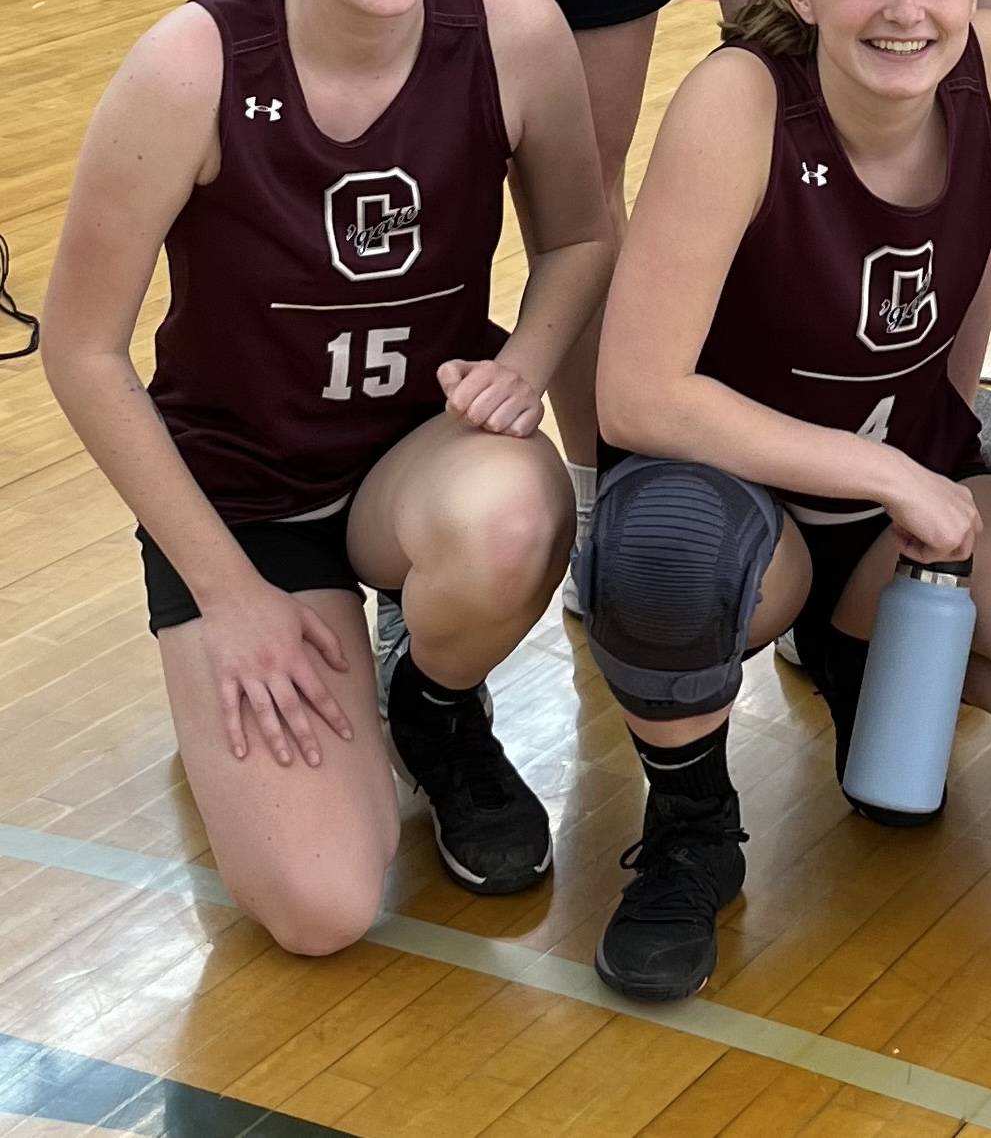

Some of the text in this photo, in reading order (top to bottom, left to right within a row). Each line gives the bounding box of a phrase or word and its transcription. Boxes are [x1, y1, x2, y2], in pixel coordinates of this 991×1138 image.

[324, 166, 422, 281] C
[322, 327, 411, 400] 15
[856, 394, 896, 445] 4
